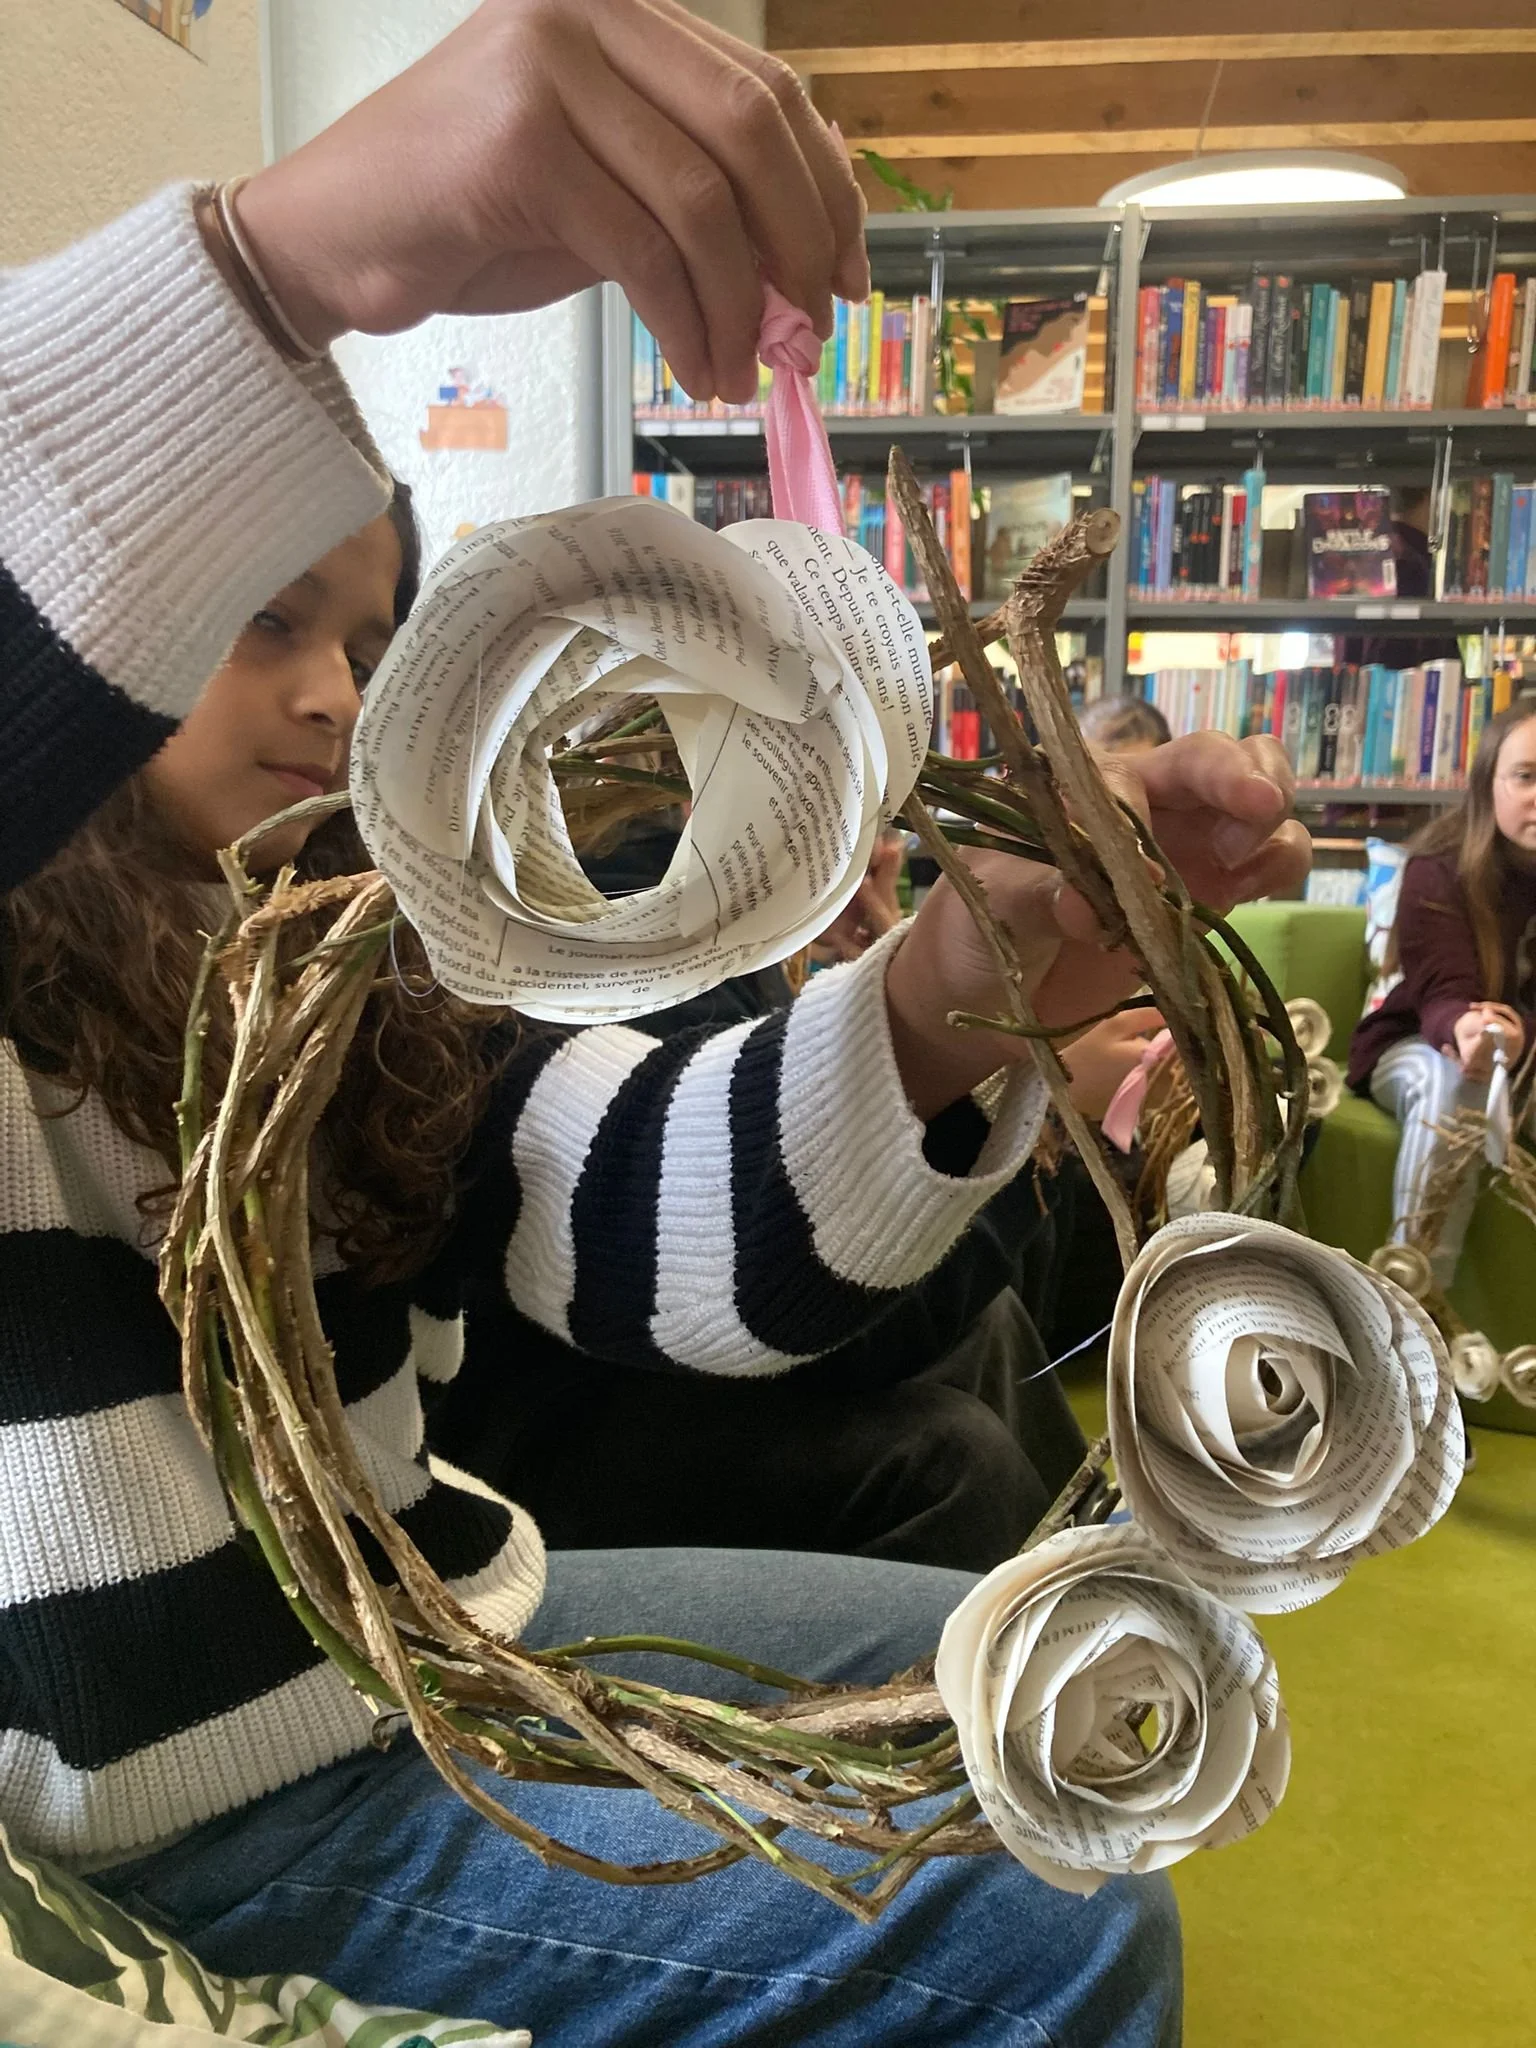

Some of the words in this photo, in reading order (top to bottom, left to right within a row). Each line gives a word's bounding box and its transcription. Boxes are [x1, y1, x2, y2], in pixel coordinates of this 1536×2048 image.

[767, 539, 790, 568] que
[804, 558, 820, 580] Ce
[817, 586, 846, 633] temps
[832, 567, 865, 625] Depuis
[863, 629, 881, 673] vingt
[885, 583, 914, 643] a-t-elle
[849, 565, 867, 584] Je
[866, 591, 879, 607] te
[876, 614, 901, 670] croyais
[896, 677, 912, 716] mon
[906, 722, 921, 769] amie,
[745, 718, 760, 735] ses
[802, 738, 816, 754] et
[742, 733, 752, 751] le
[752, 746, 789, 795] souvenir
[768, 796, 780, 811] et
[745, 822, 761, 852] Pour
[436, 951, 471, 975] bord
[474, 964, 496, 983] du
[525, 966, 540, 976] la
[543, 969, 604, 979] tristesse
[609, 970, 628, 978] de
[632, 965, 667, 976] faire
[671, 954, 702, 970] part
[705, 945, 722, 955] du
[595, 976, 654, 989] survenu
[658, 971, 672, 981] le
[675, 969, 685, 978] 6
[631, 986, 650, 994] de
[1282, 1573, 1319, 1591] qu'au
